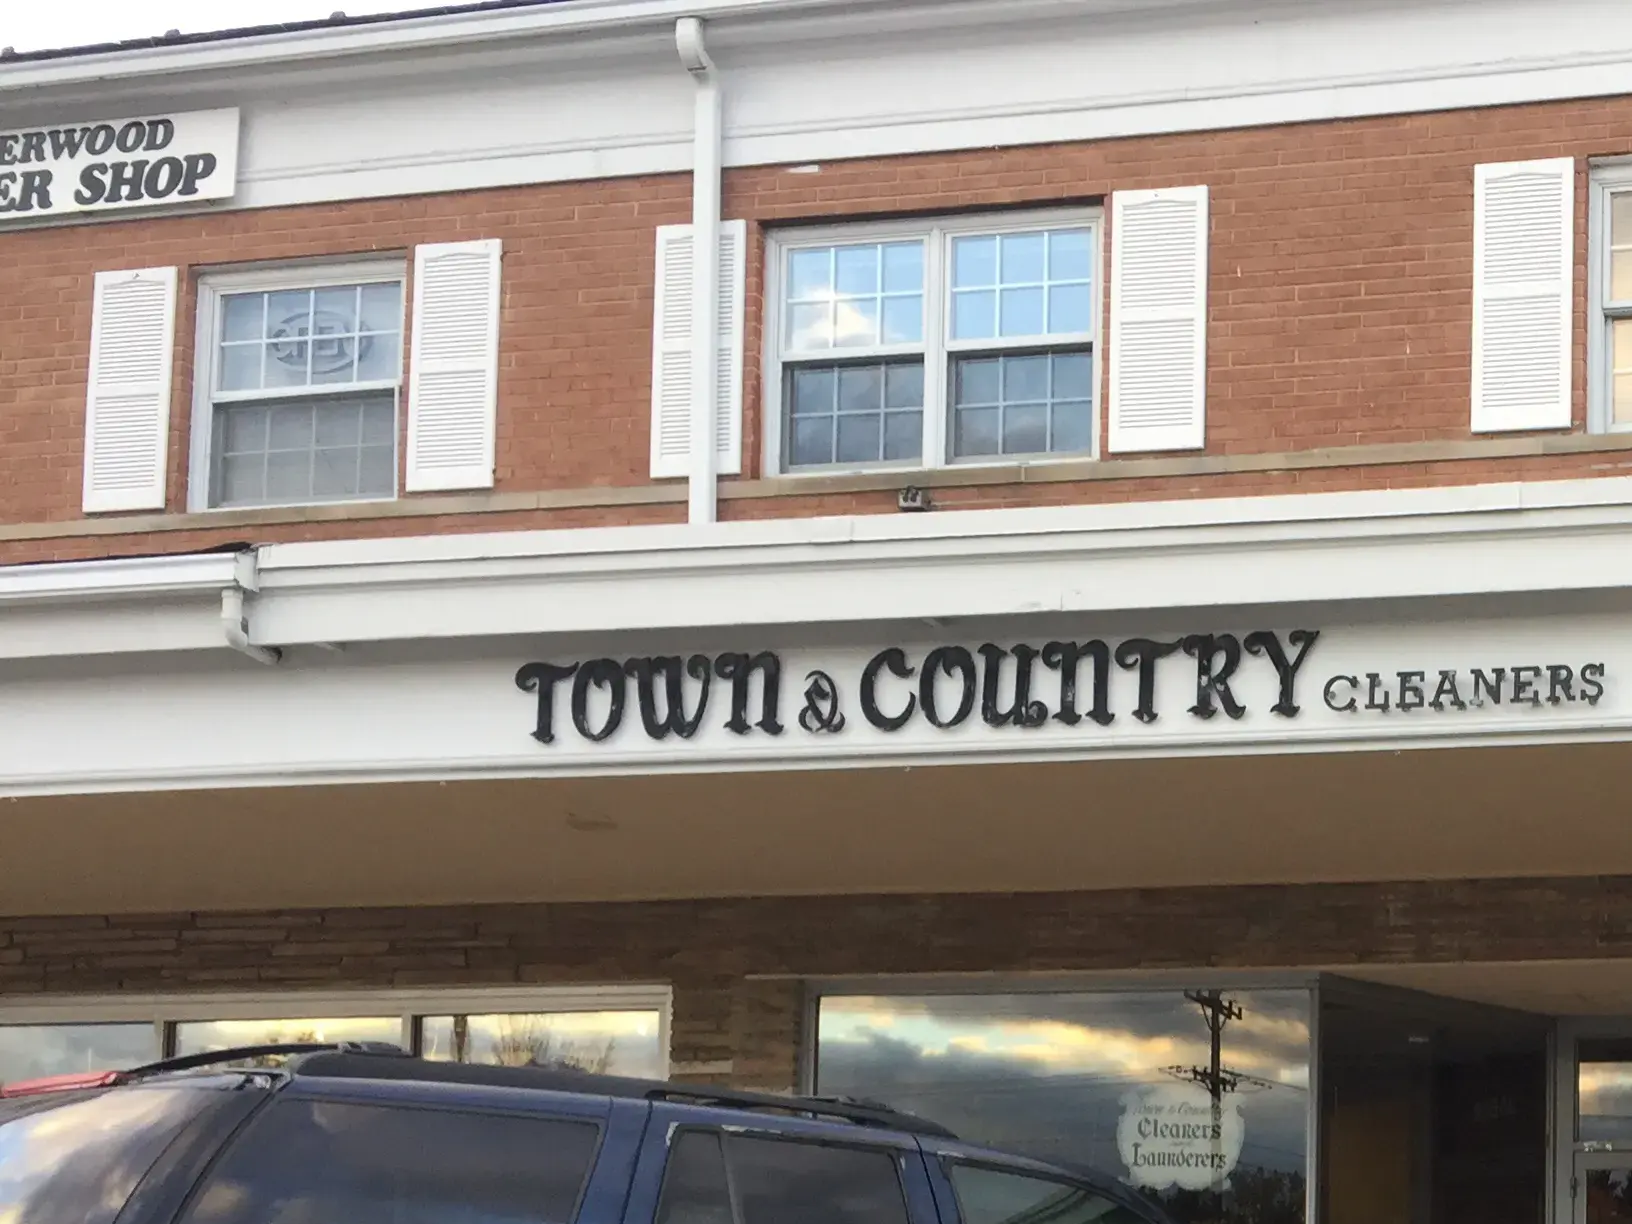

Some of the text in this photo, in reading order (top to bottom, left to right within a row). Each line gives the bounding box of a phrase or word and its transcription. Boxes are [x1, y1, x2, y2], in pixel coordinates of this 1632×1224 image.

[0, 118, 175, 166] ERWOOD
[74, 152, 217, 205] SHOP
[514, 629, 1605, 744] TOWN & COUNTRY CLEANERS
[1137, 1117, 1222, 1140] Cleaners
[1131, 1141, 1228, 1172] Launderers
